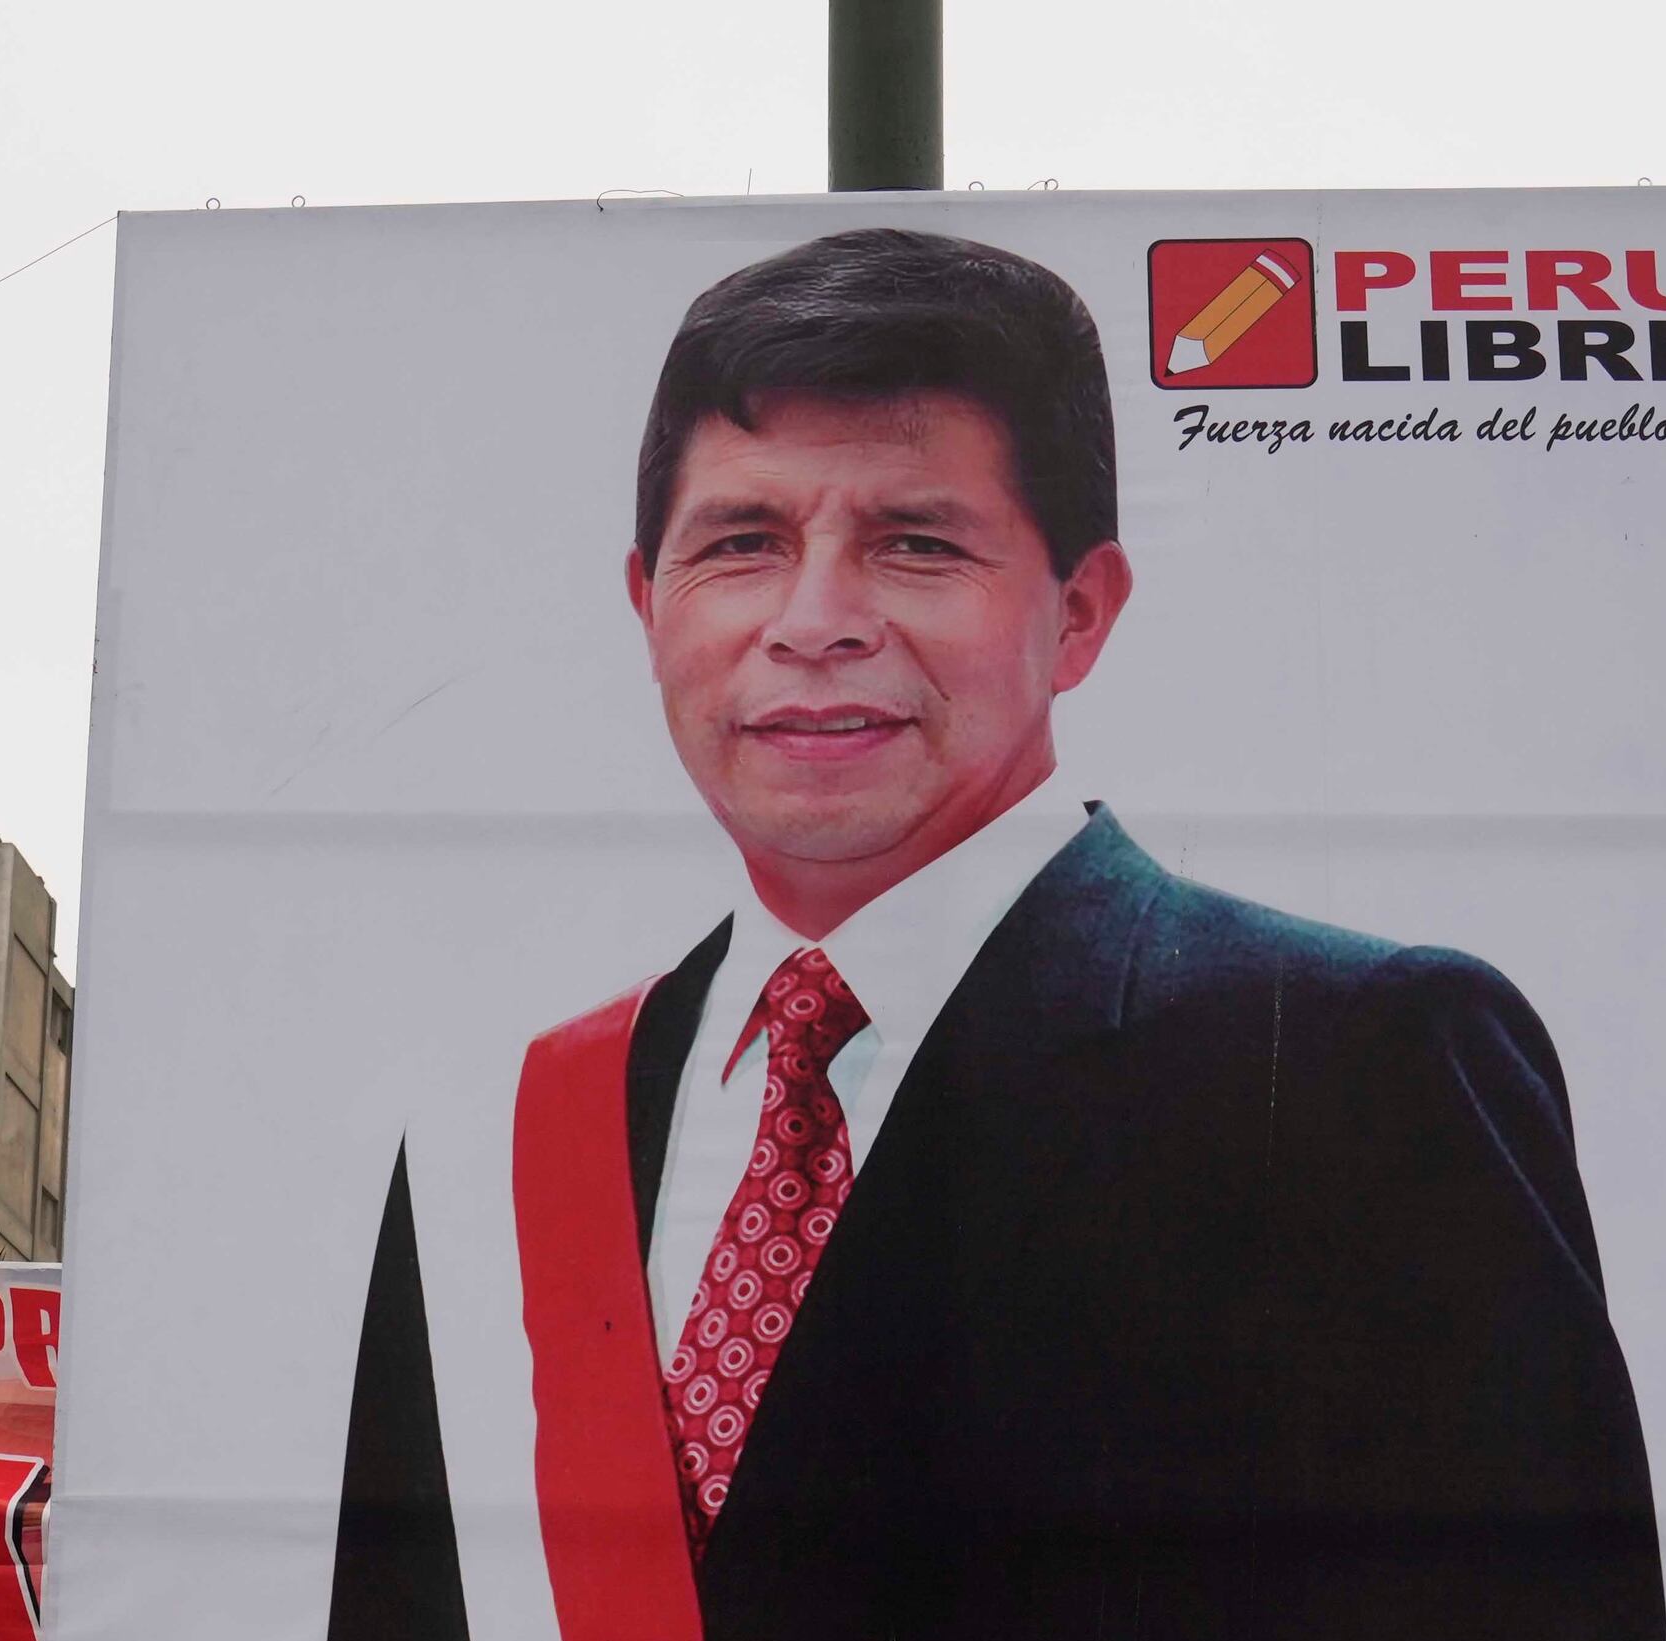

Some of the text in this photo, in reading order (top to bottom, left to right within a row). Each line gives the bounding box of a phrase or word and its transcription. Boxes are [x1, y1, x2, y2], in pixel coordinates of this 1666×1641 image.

[1173, 404, 1313, 454] Fuerza
[1328, 405, 1462, 442] nacida
[1476, 405, 1536, 442] del
